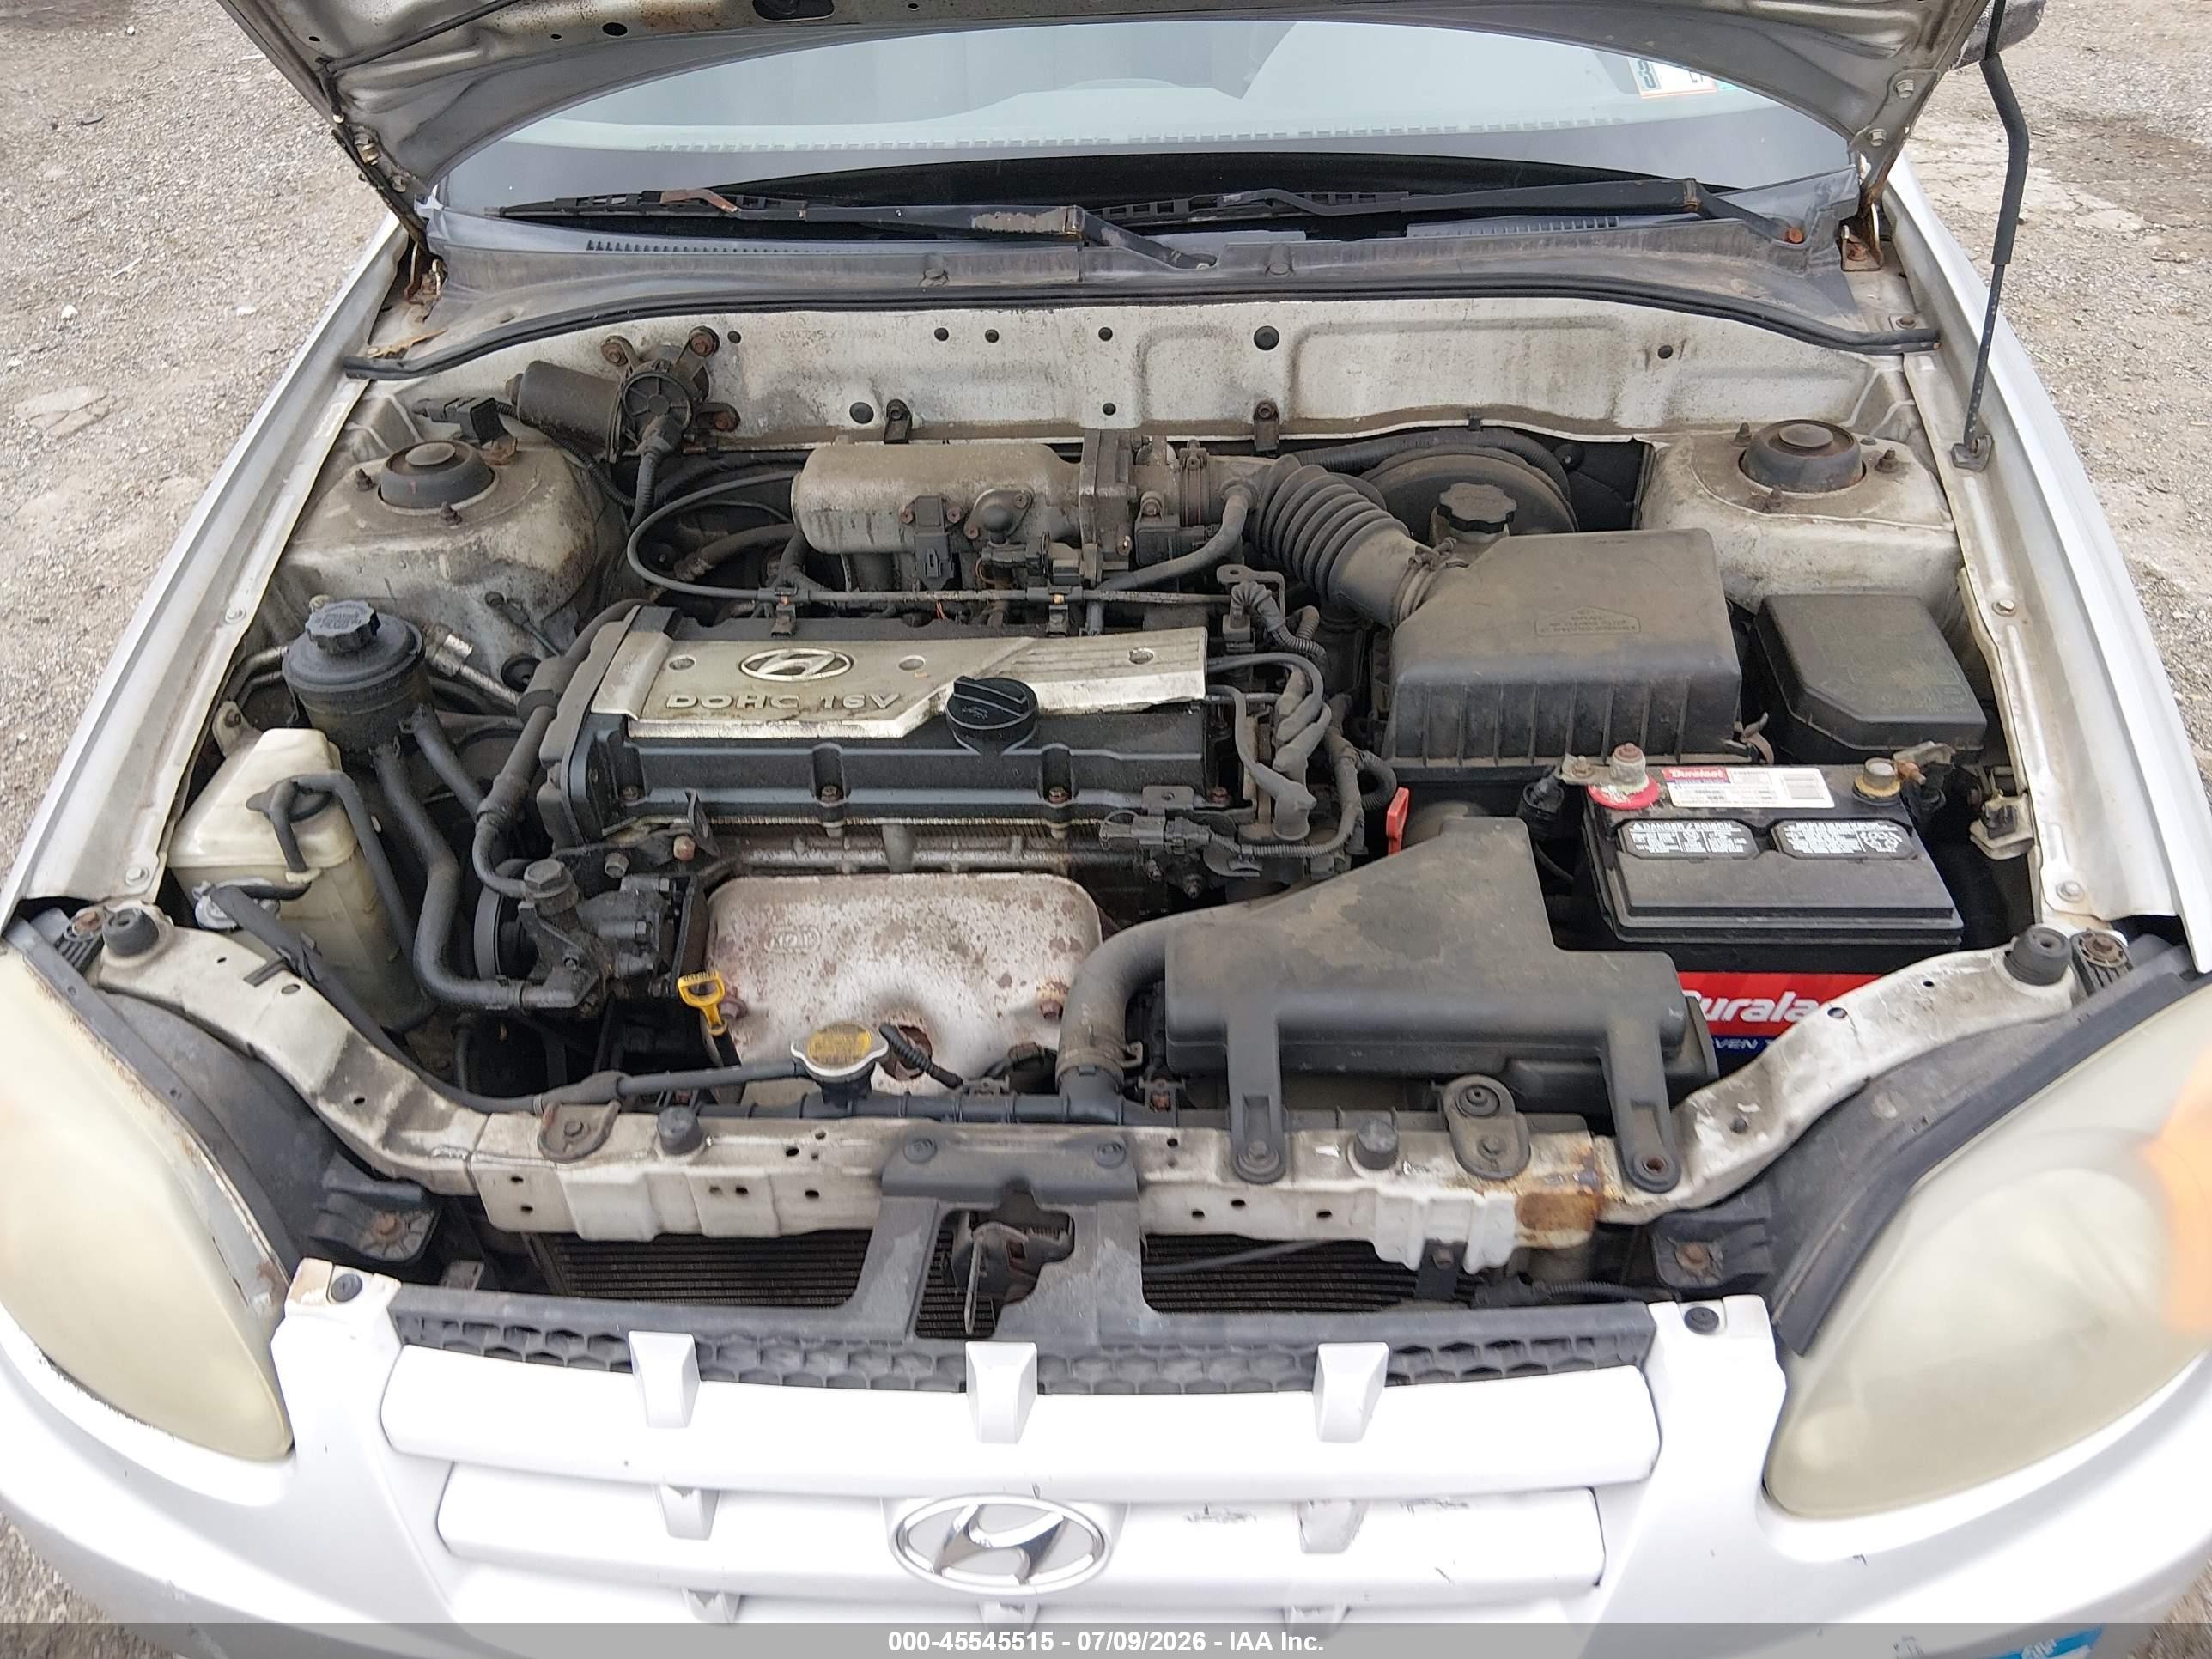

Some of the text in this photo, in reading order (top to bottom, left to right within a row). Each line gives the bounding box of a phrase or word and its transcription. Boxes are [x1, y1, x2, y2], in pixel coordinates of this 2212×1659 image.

[666, 693, 900, 709] DOHC 16V
[1712, 1038, 1759, 1050] VEN
